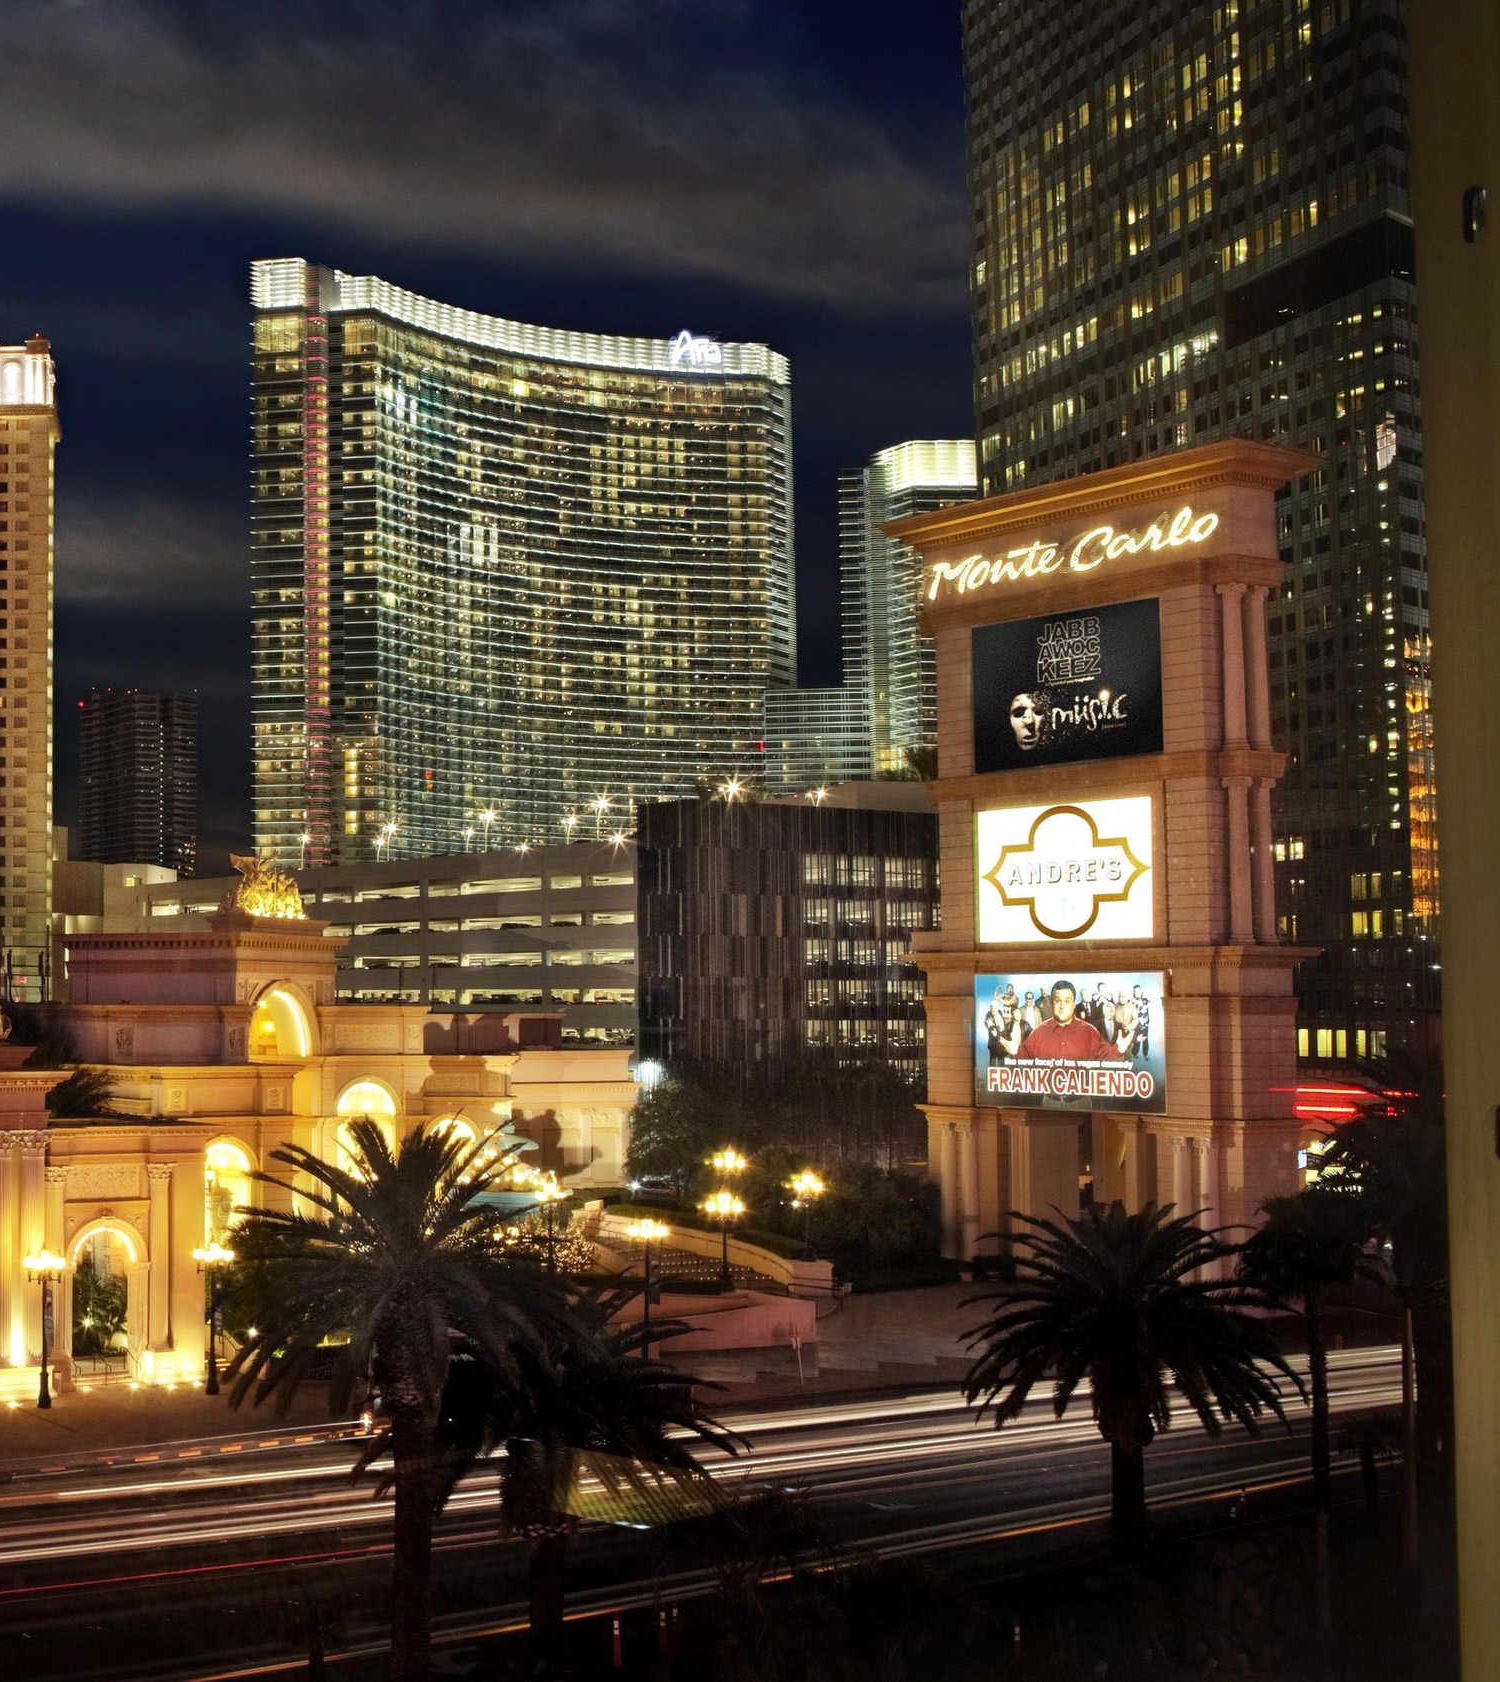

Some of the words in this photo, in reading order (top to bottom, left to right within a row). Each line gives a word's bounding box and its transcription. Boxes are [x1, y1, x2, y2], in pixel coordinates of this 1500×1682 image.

[927, 541, 1064, 600] Monte
[1068, 506, 1219, 572] Carlo
[1037, 616, 1101, 645] JABB
[1038, 637, 1101, 662] AWOC
[1037, 654, 1101, 683] KEEZ
[1007, 857, 1123, 887] ANDRE'S
[1054, 1058, 1064, 1066] of
[987, 1066, 1051, 1095] FRANK
[1051, 1067, 1154, 1100] CALIENDO
